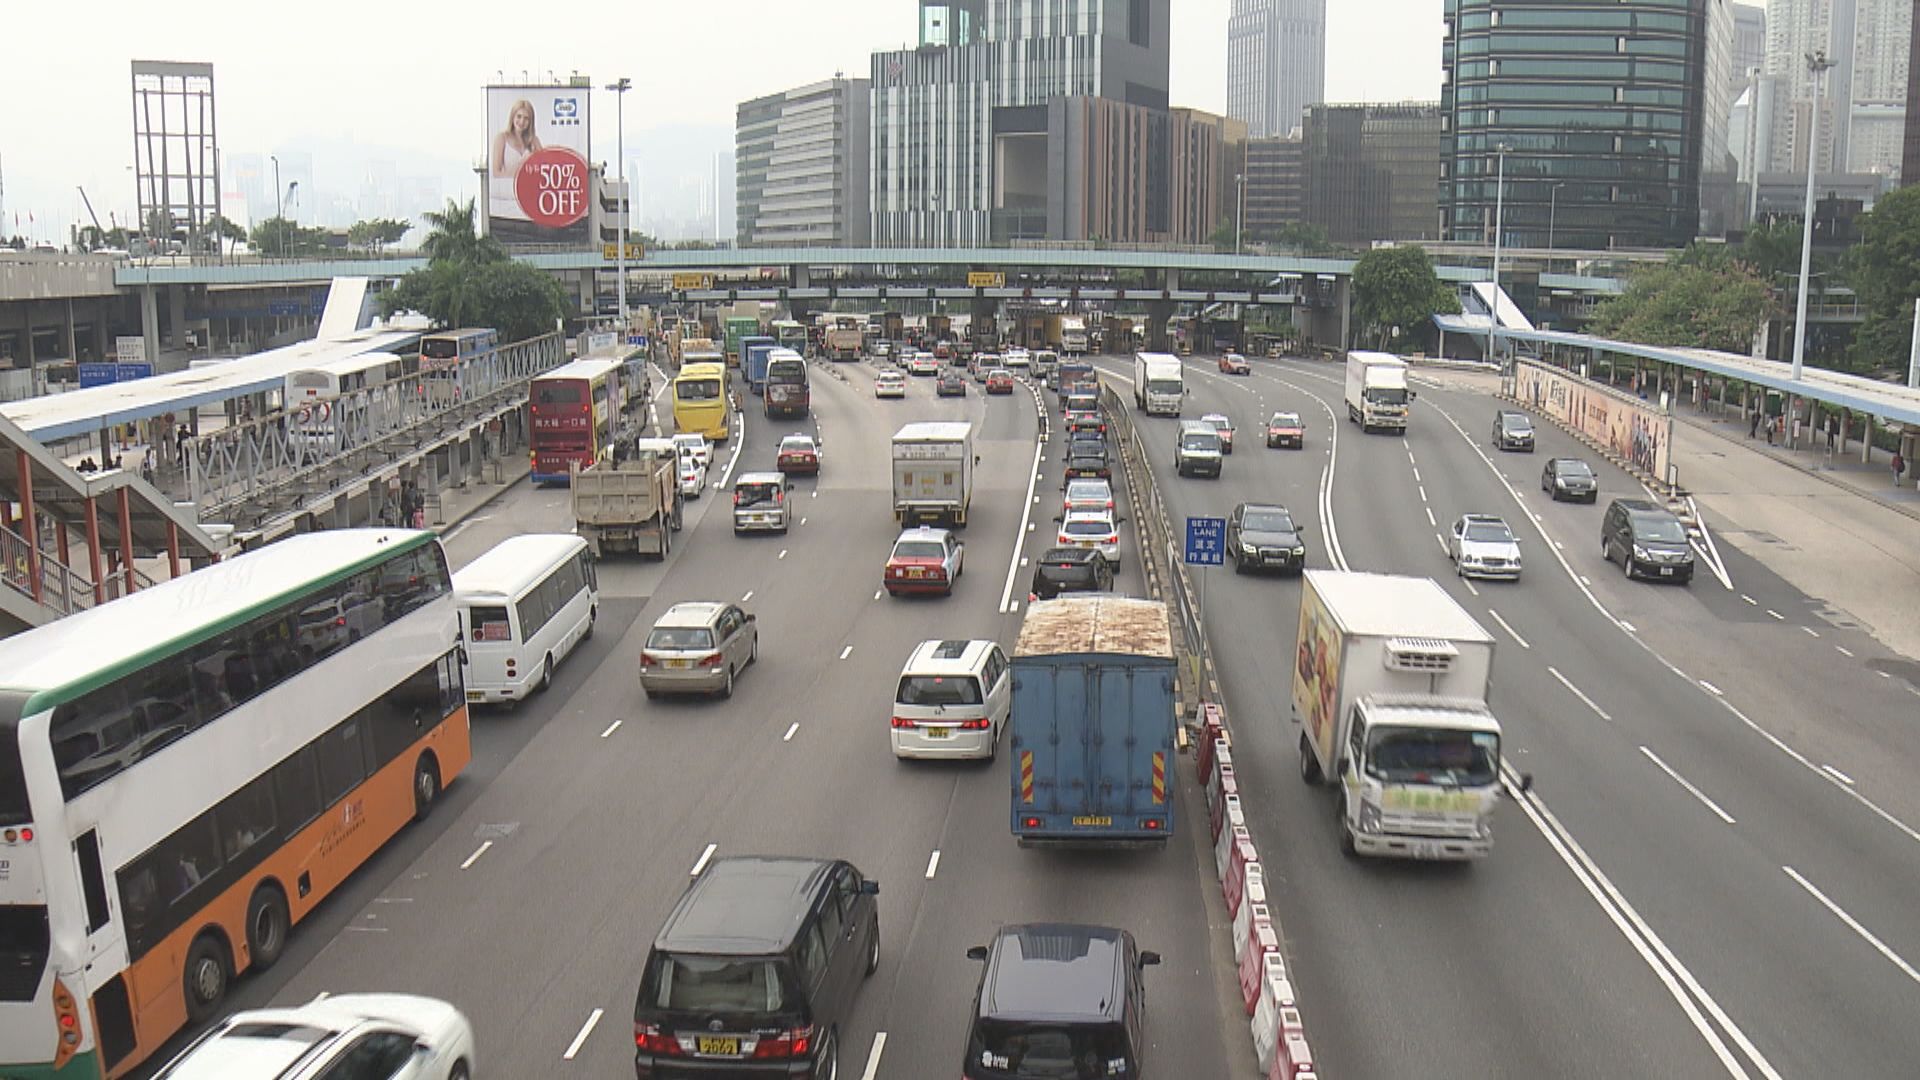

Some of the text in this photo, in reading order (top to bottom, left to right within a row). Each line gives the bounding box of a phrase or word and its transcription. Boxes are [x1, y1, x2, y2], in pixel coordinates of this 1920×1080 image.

[539, 163, 581, 190] 50%
[1191, 520, 1221, 529] GET IN
[1194, 528, 1217, 537] LANE
